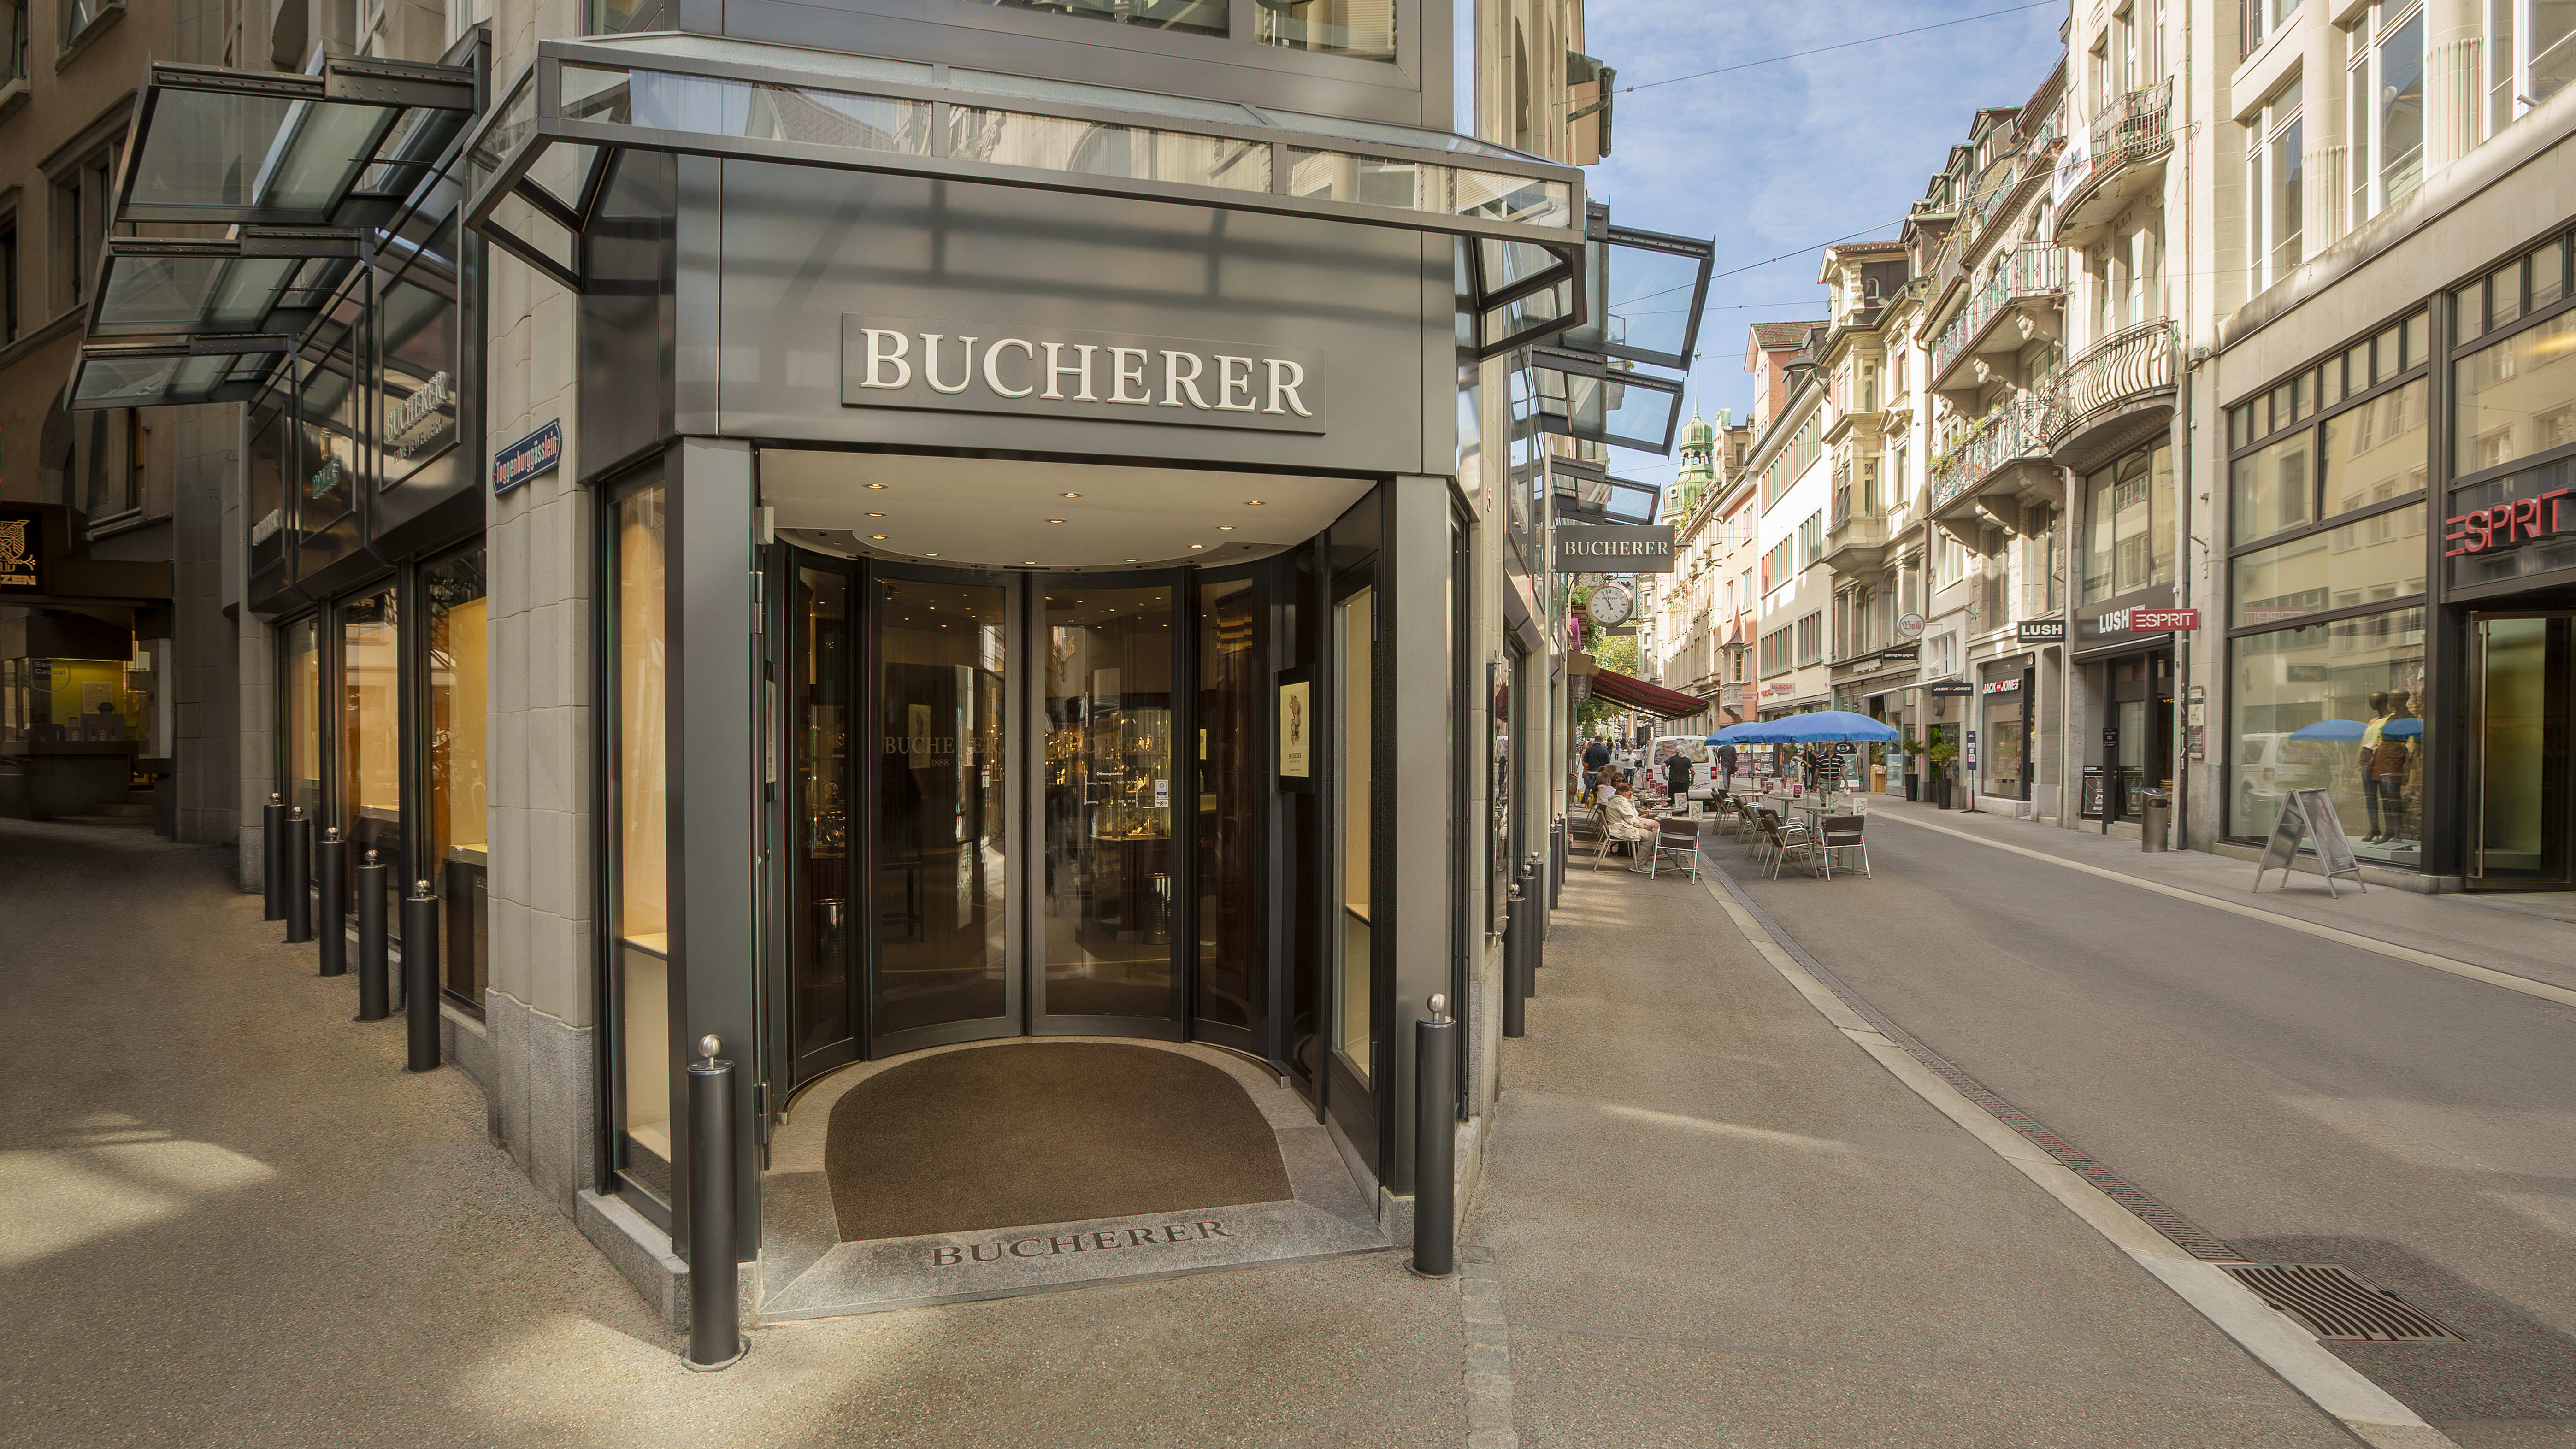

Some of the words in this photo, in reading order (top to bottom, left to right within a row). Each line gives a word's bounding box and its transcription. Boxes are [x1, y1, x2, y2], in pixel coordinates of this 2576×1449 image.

[860, 328, 1312, 417] BUCHERER
[387, 371, 450, 441] BUCHERER
[394, 445, 407, 464] FINE
[408, 417, 442, 458] JEWELLERY
[496, 431, 557, 484] Toggenburggässlein
[2446, 488, 2569, 557] ESPRIT
[1564, 541, 1669, 556] BUCHERER
[1902, 621, 1922, 630] Bolli
[2021, 624, 2063, 635] LUSH
[2099, 608, 2129, 634] LUSH
[2135, 613, 2194, 628] ESPRIT
[2028, 653, 2034, 665] 18
[1982, 682, 1997, 695] JACK
[2001, 679, 2019, 692] JONES
[885, 736, 1004, 754] BUCHEER
[931, 759, 949, 767] 1888
[932, 1221, 1233, 1267] BUCHERER
